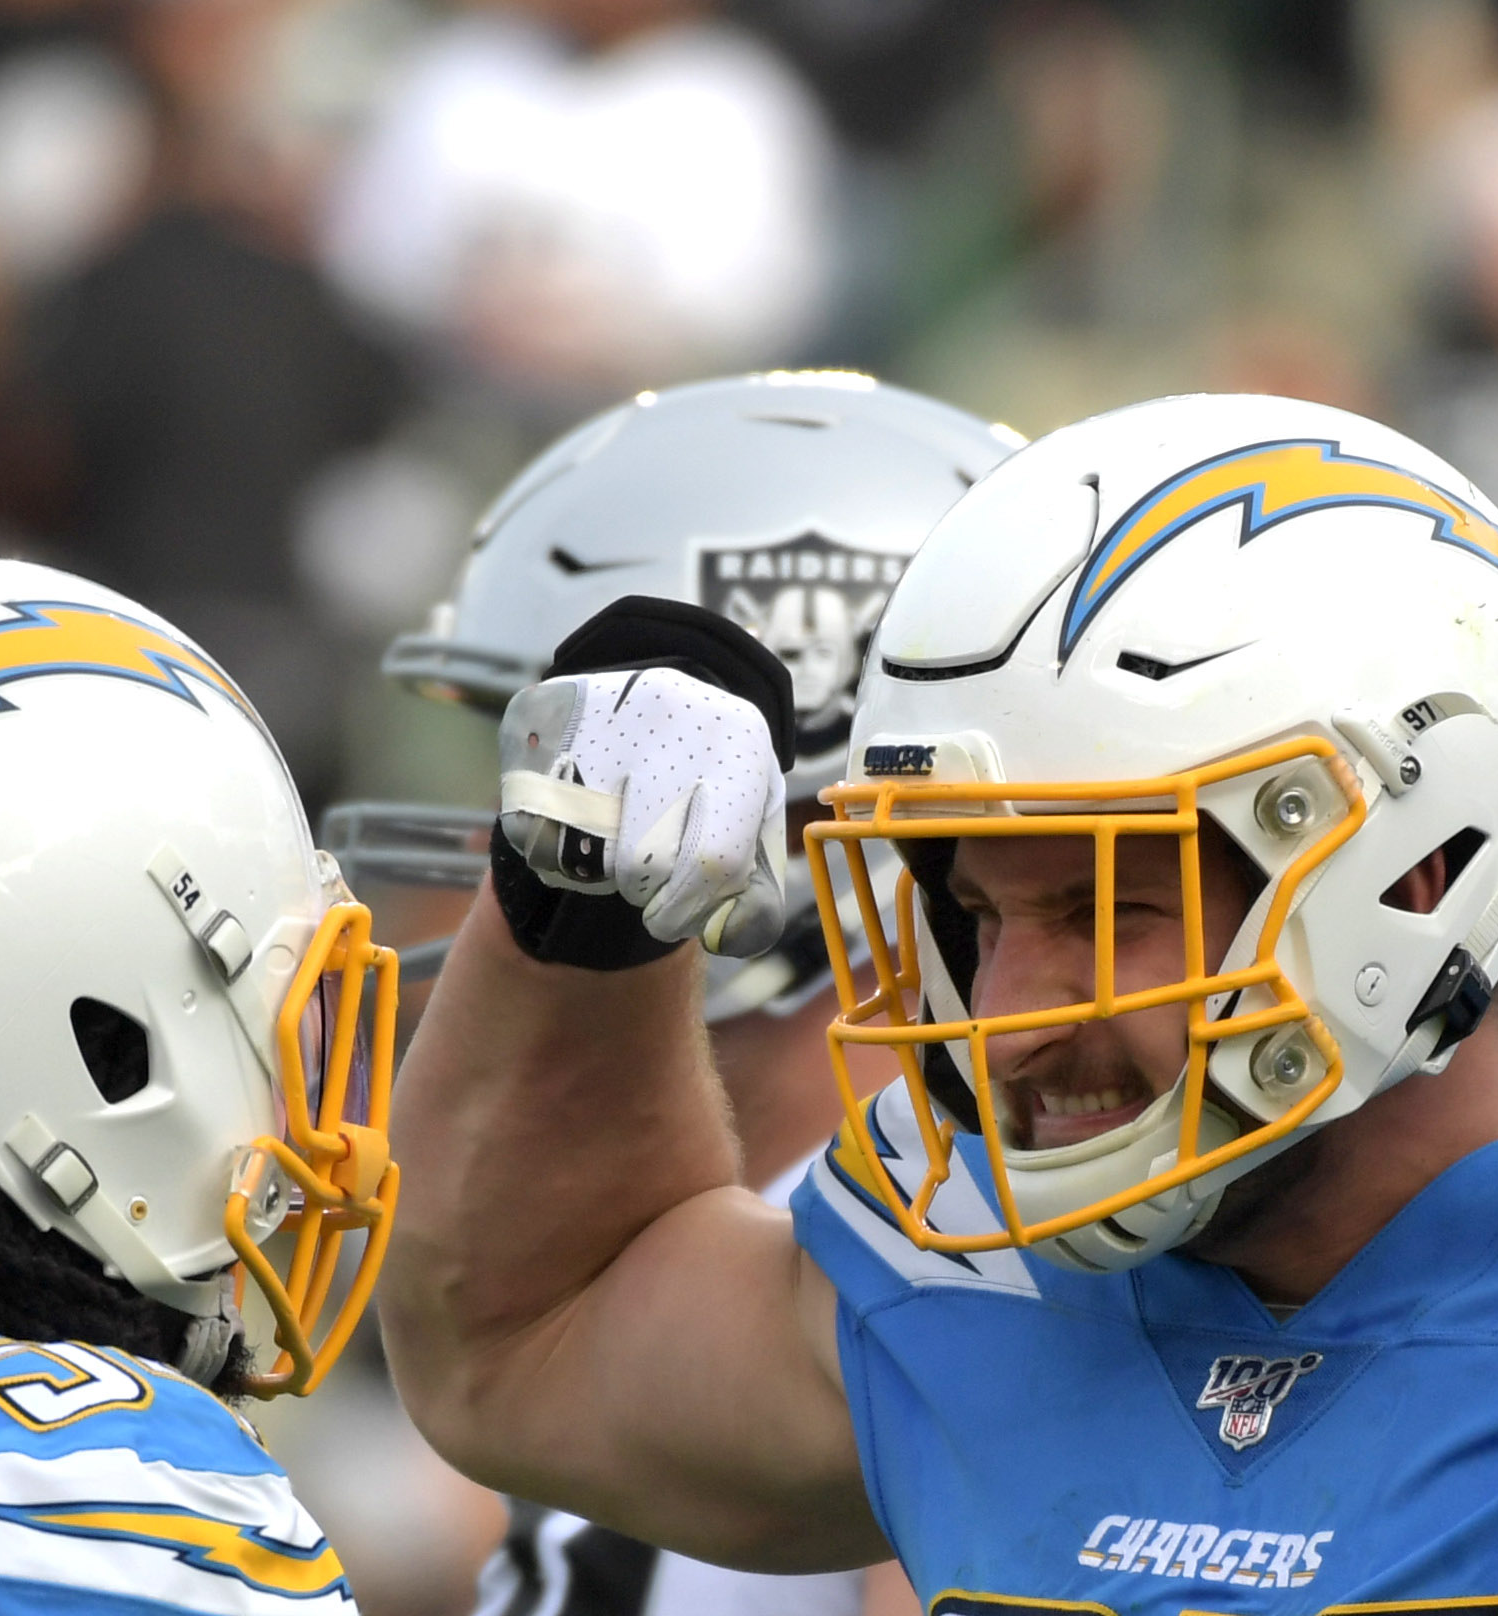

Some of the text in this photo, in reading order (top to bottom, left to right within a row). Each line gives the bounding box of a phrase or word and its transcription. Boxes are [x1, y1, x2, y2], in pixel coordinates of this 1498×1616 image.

[1402, 700, 1437, 731] 97
[172, 872, 201, 912] 54
[1228, 1413, 1259, 1437] NFL
[1077, 1514, 1335, 1589] CHARGERS
